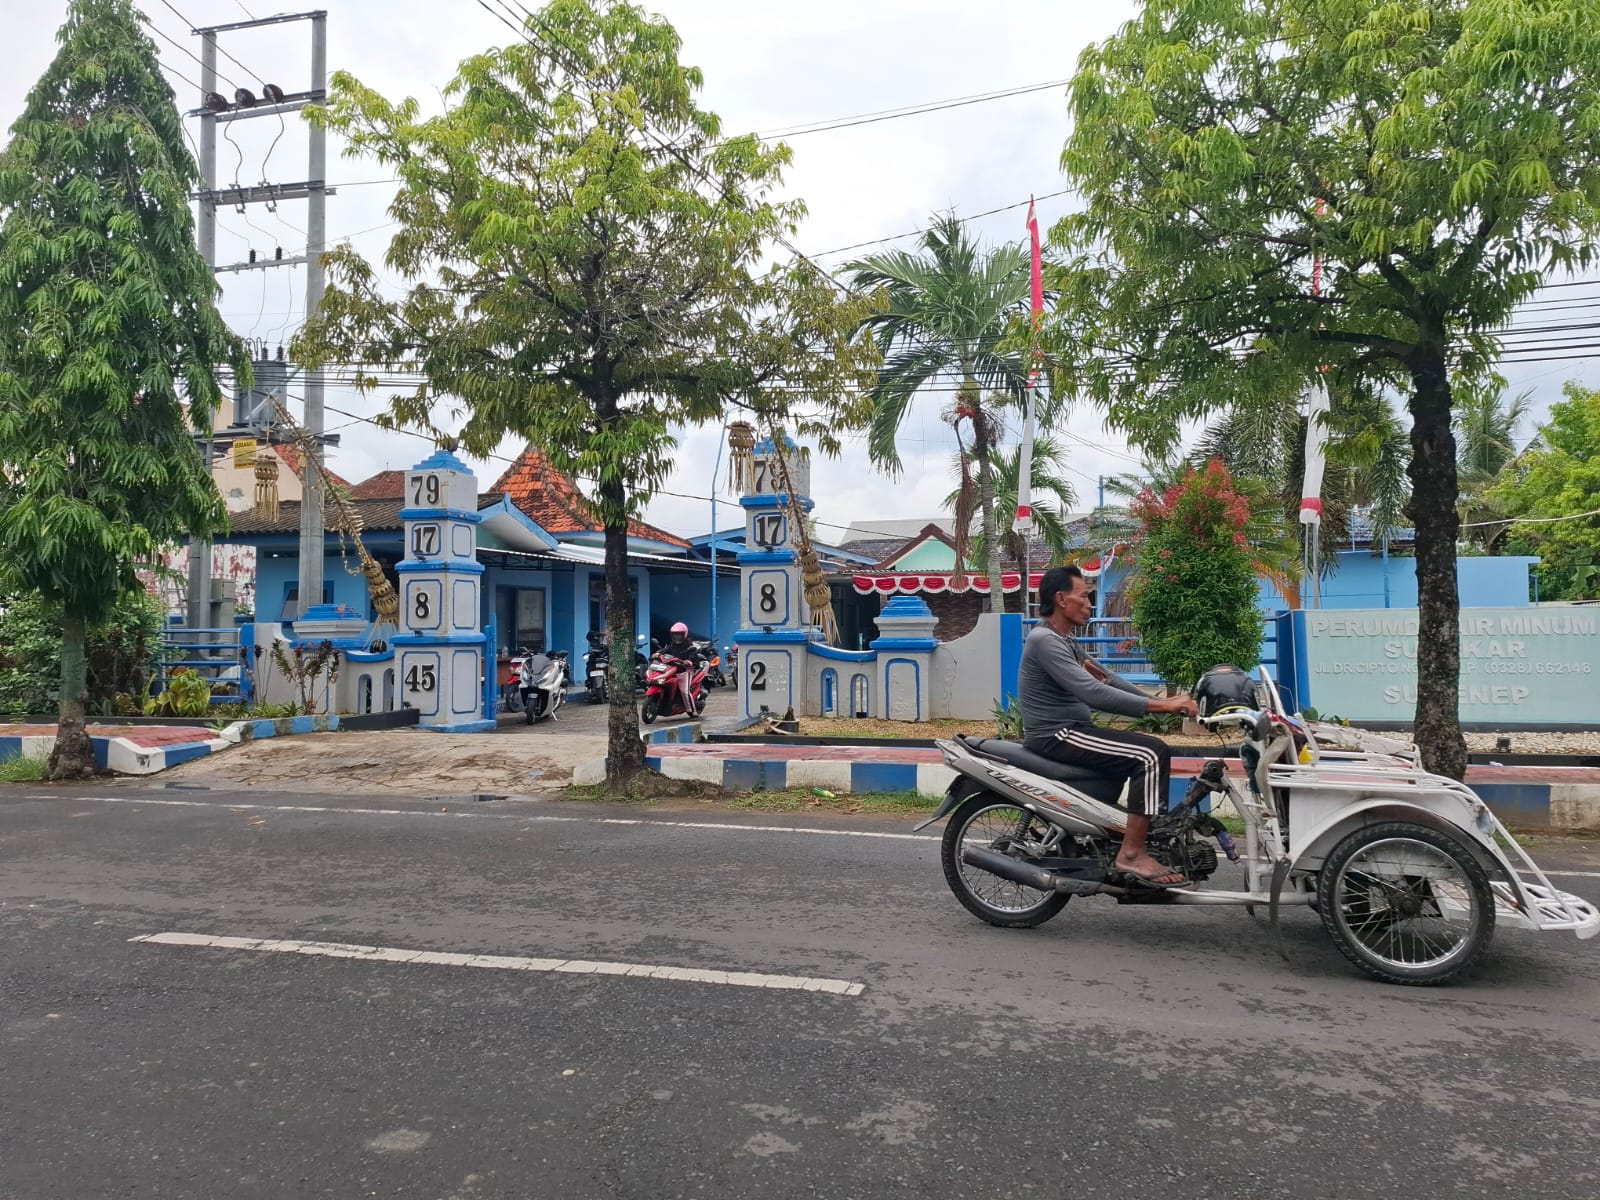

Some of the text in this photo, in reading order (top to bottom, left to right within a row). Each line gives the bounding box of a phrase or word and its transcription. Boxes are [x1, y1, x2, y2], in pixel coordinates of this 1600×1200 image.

[411, 474, 440, 505] 79
[414, 526, 437, 554] 17
[757, 516, 782, 546] 17
[415, 592, 430, 619] 8
[760, 583, 777, 612] 8
[1311, 618, 1419, 637] PERUMD
[1500, 615, 1597, 636] MINUM
[1384, 639, 1528, 659] SUKAR
[405, 663, 436, 692] 45
[750, 661, 766, 691] 2
[1485, 662, 1532, 675] (0328)
[1535, 661, 1592, 675] 662148
